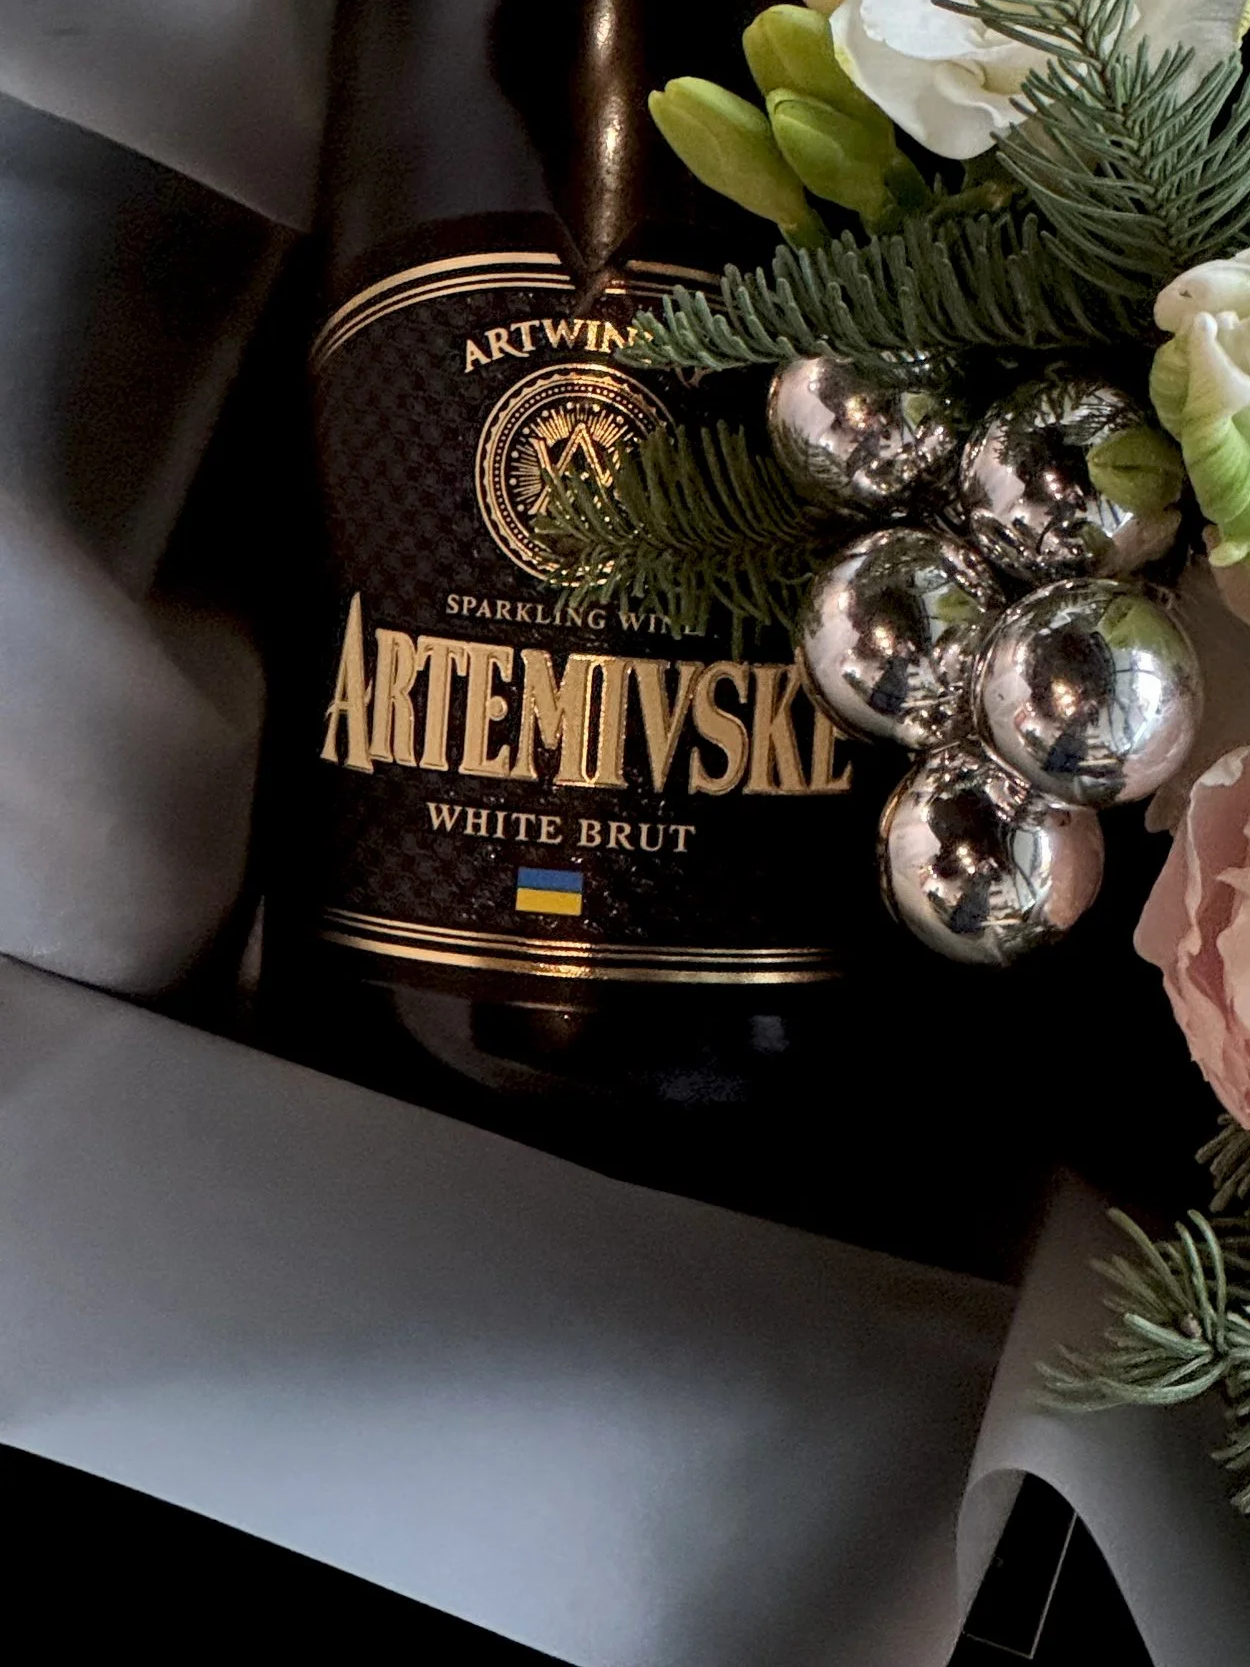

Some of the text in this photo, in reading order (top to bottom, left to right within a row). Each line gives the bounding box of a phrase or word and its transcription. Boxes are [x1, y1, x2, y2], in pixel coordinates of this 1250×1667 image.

[463, 317, 656, 374] ARTWIN
[446, 593, 607, 631] SPARKLING
[426, 801, 697, 854] WHITE BRUT
